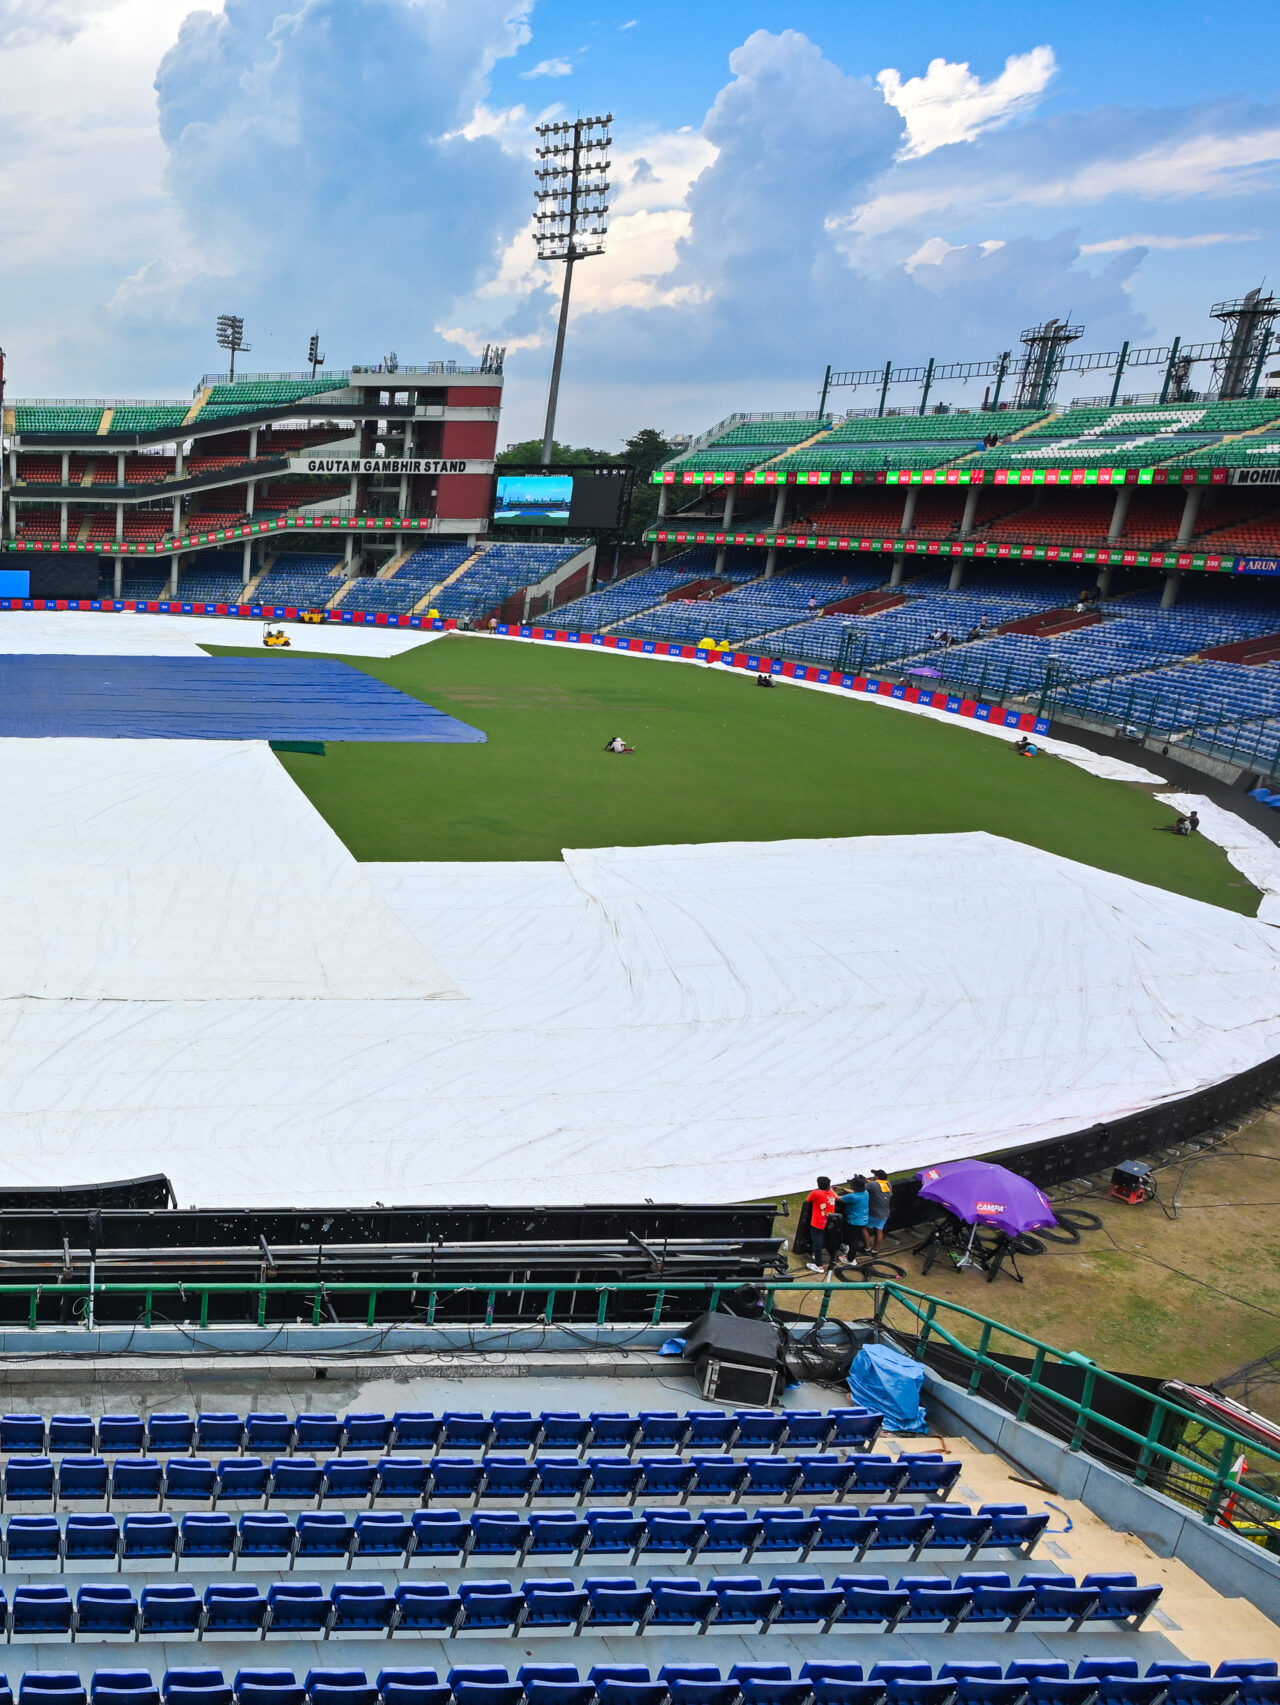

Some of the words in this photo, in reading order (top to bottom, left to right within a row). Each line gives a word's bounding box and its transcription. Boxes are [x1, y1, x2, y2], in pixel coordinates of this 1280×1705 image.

[308, 461, 360, 472] GAUTAM
[364, 461, 420, 472] GAMBHIR
[424, 461, 466, 472] STAND
[1246, 561, 1277, 570] ARUN
[977, 708, 988, 716] 248
[1007, 716, 1017, 724] 250
[1036, 723, 1046, 731] 252
[977, 1204, 1004, 1212] CAMPA
